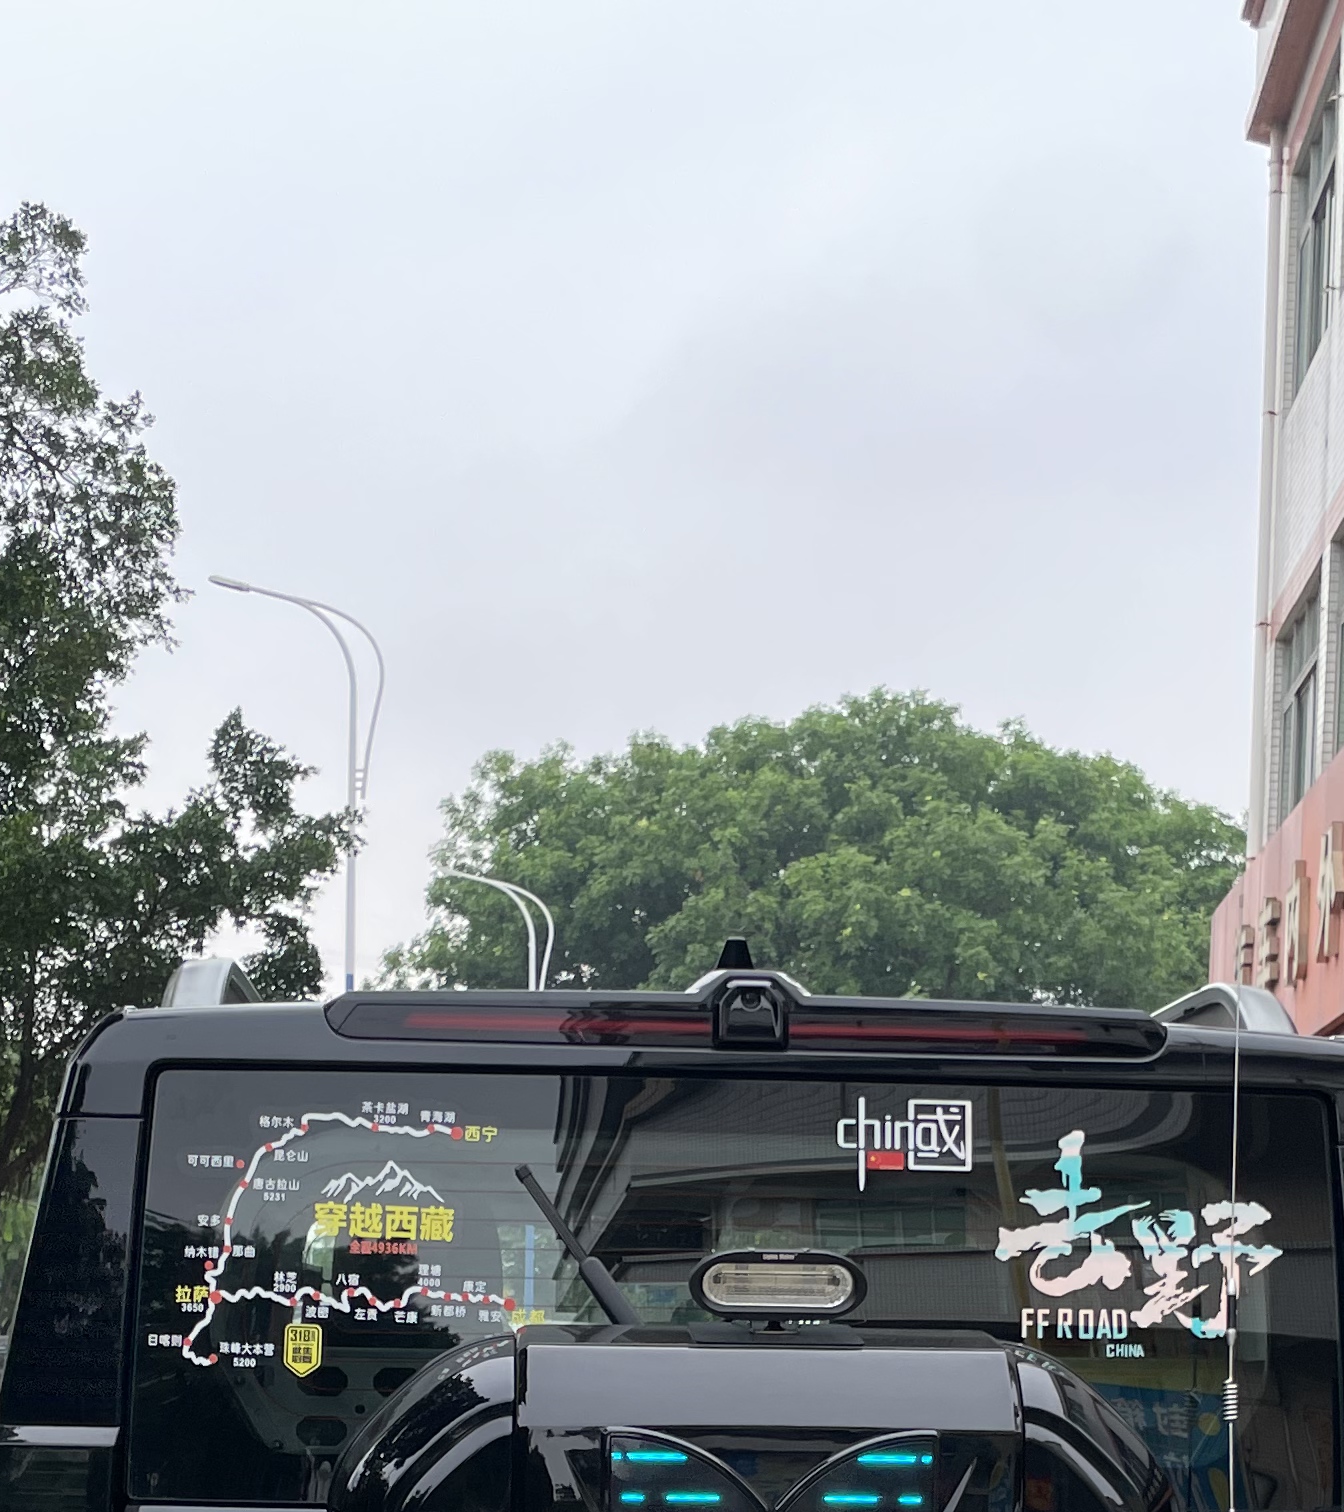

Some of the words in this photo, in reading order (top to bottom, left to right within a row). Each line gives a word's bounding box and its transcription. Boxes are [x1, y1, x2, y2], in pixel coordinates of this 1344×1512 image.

[259, 1115, 295, 1129] 格尔木
[373, 1114, 397, 1125] 3200
[419, 1109, 456, 1123] 青海湖
[464, 1125, 498, 1143] 西宁
[187, 1154, 235, 1168] 可可西里
[273, 1149, 309, 1163] 昆仑山
[252, 1177, 300, 1191] 唐古拉山
[263, 1191, 286, 1201] 5231
[197, 1213, 221, 1227] 安多
[314, 1201, 455, 1243] 穿越西藏
[231, 1244, 256, 1258] 那曲
[273, 1270, 298, 1284] 林芝
[417, 1276, 441, 1287] 4000
[174, 1284, 209, 1303] 拉萨
[462, 1280, 487, 1293] 康定
[180, 1303, 205, 1313] 3650
[510, 1309, 546, 1325] 成都
[147, 1333, 183, 1347] 日喀则
[219, 1342, 276, 1357] 珠峰大本营
[1106, 1343, 1146, 1358] CHINA
[233, 1357, 257, 1367] 5200
